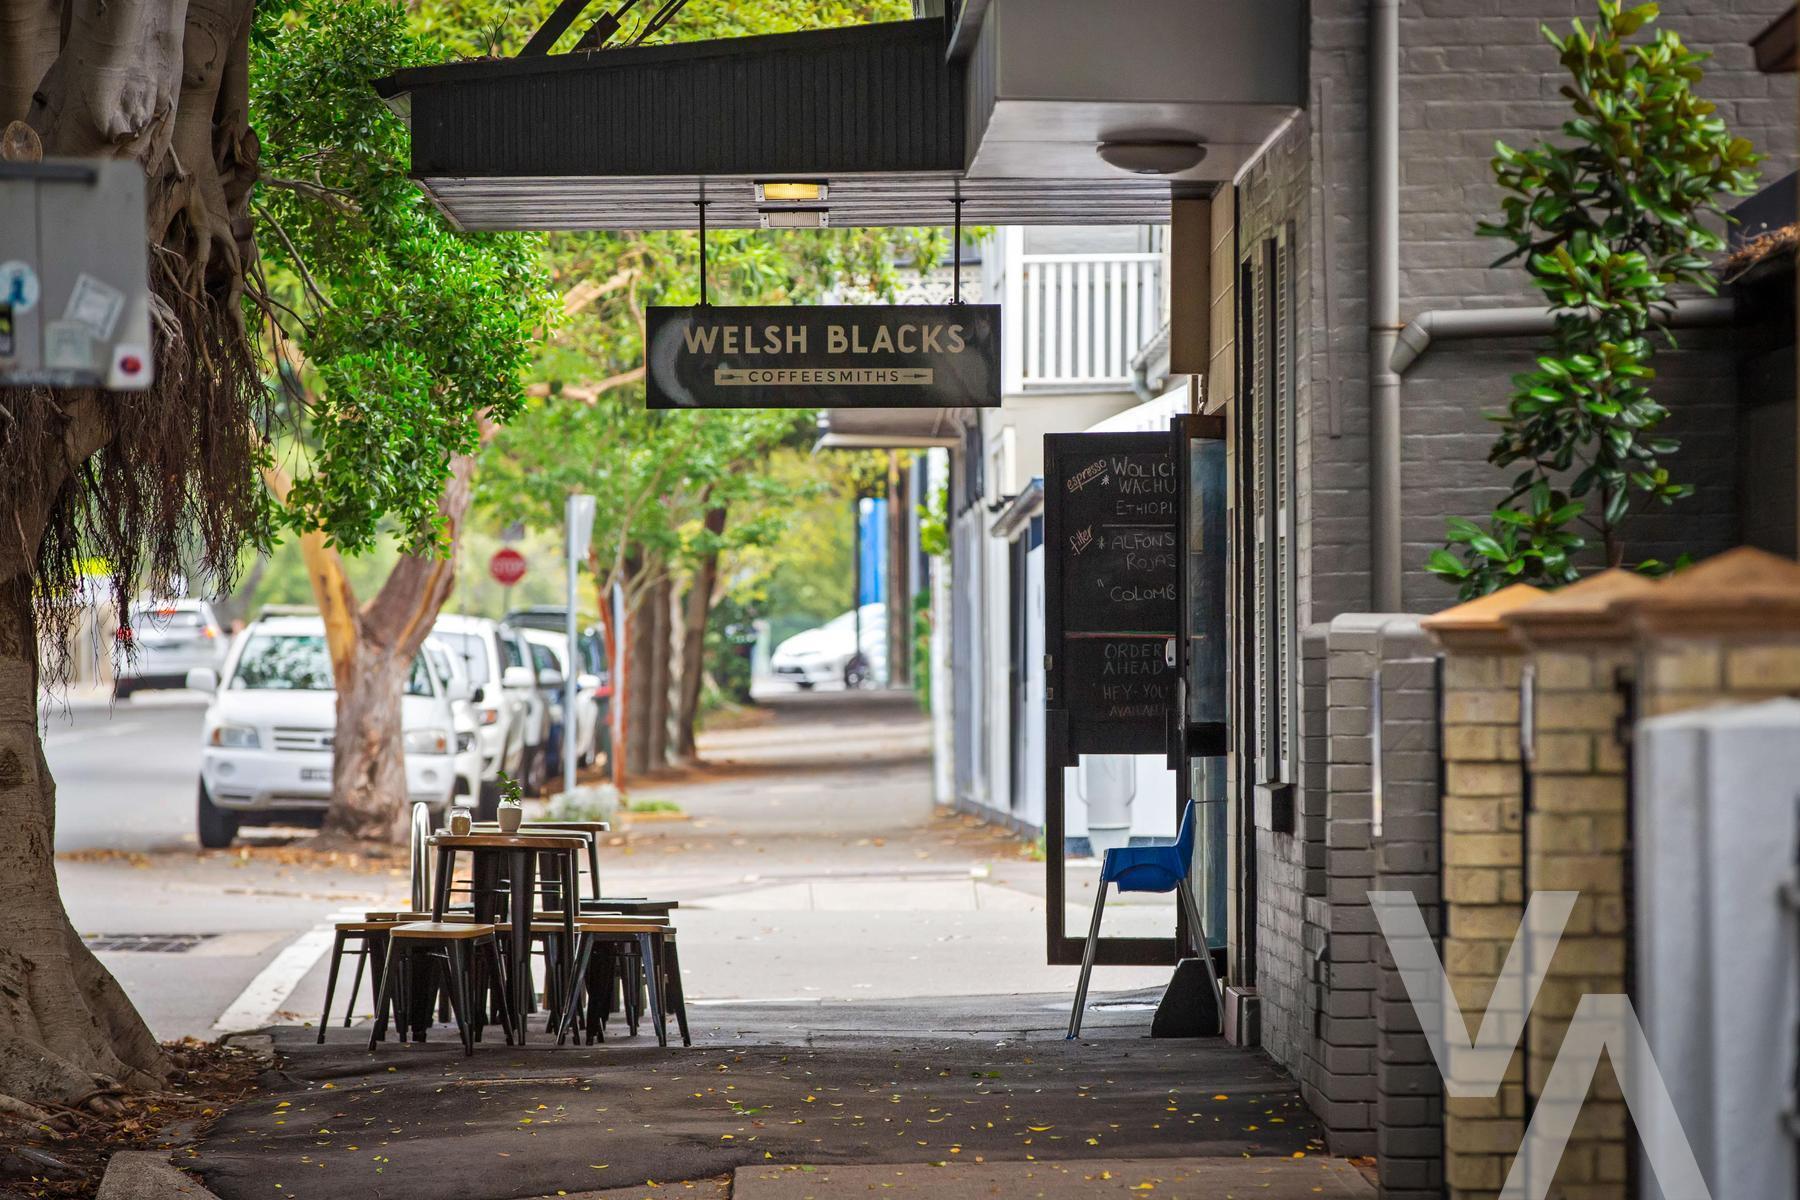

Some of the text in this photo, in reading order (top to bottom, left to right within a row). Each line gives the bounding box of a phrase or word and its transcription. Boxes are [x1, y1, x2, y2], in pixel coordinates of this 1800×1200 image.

[683, 324, 966, 354] WELSH BLACKS
[748, 370, 899, 383] COFFEESMITHS
[1066, 458, 1107, 491] espresso
[1116, 500, 1176, 516] ETHIOPI
[1069, 524, 1093, 556] filter
[1111, 532, 1175, 550] ALFONS
[1110, 584, 1176, 602] COLOMB
[1104, 643, 1162, 658] ORDER
[1103, 660, 1164, 676] AHEAD
